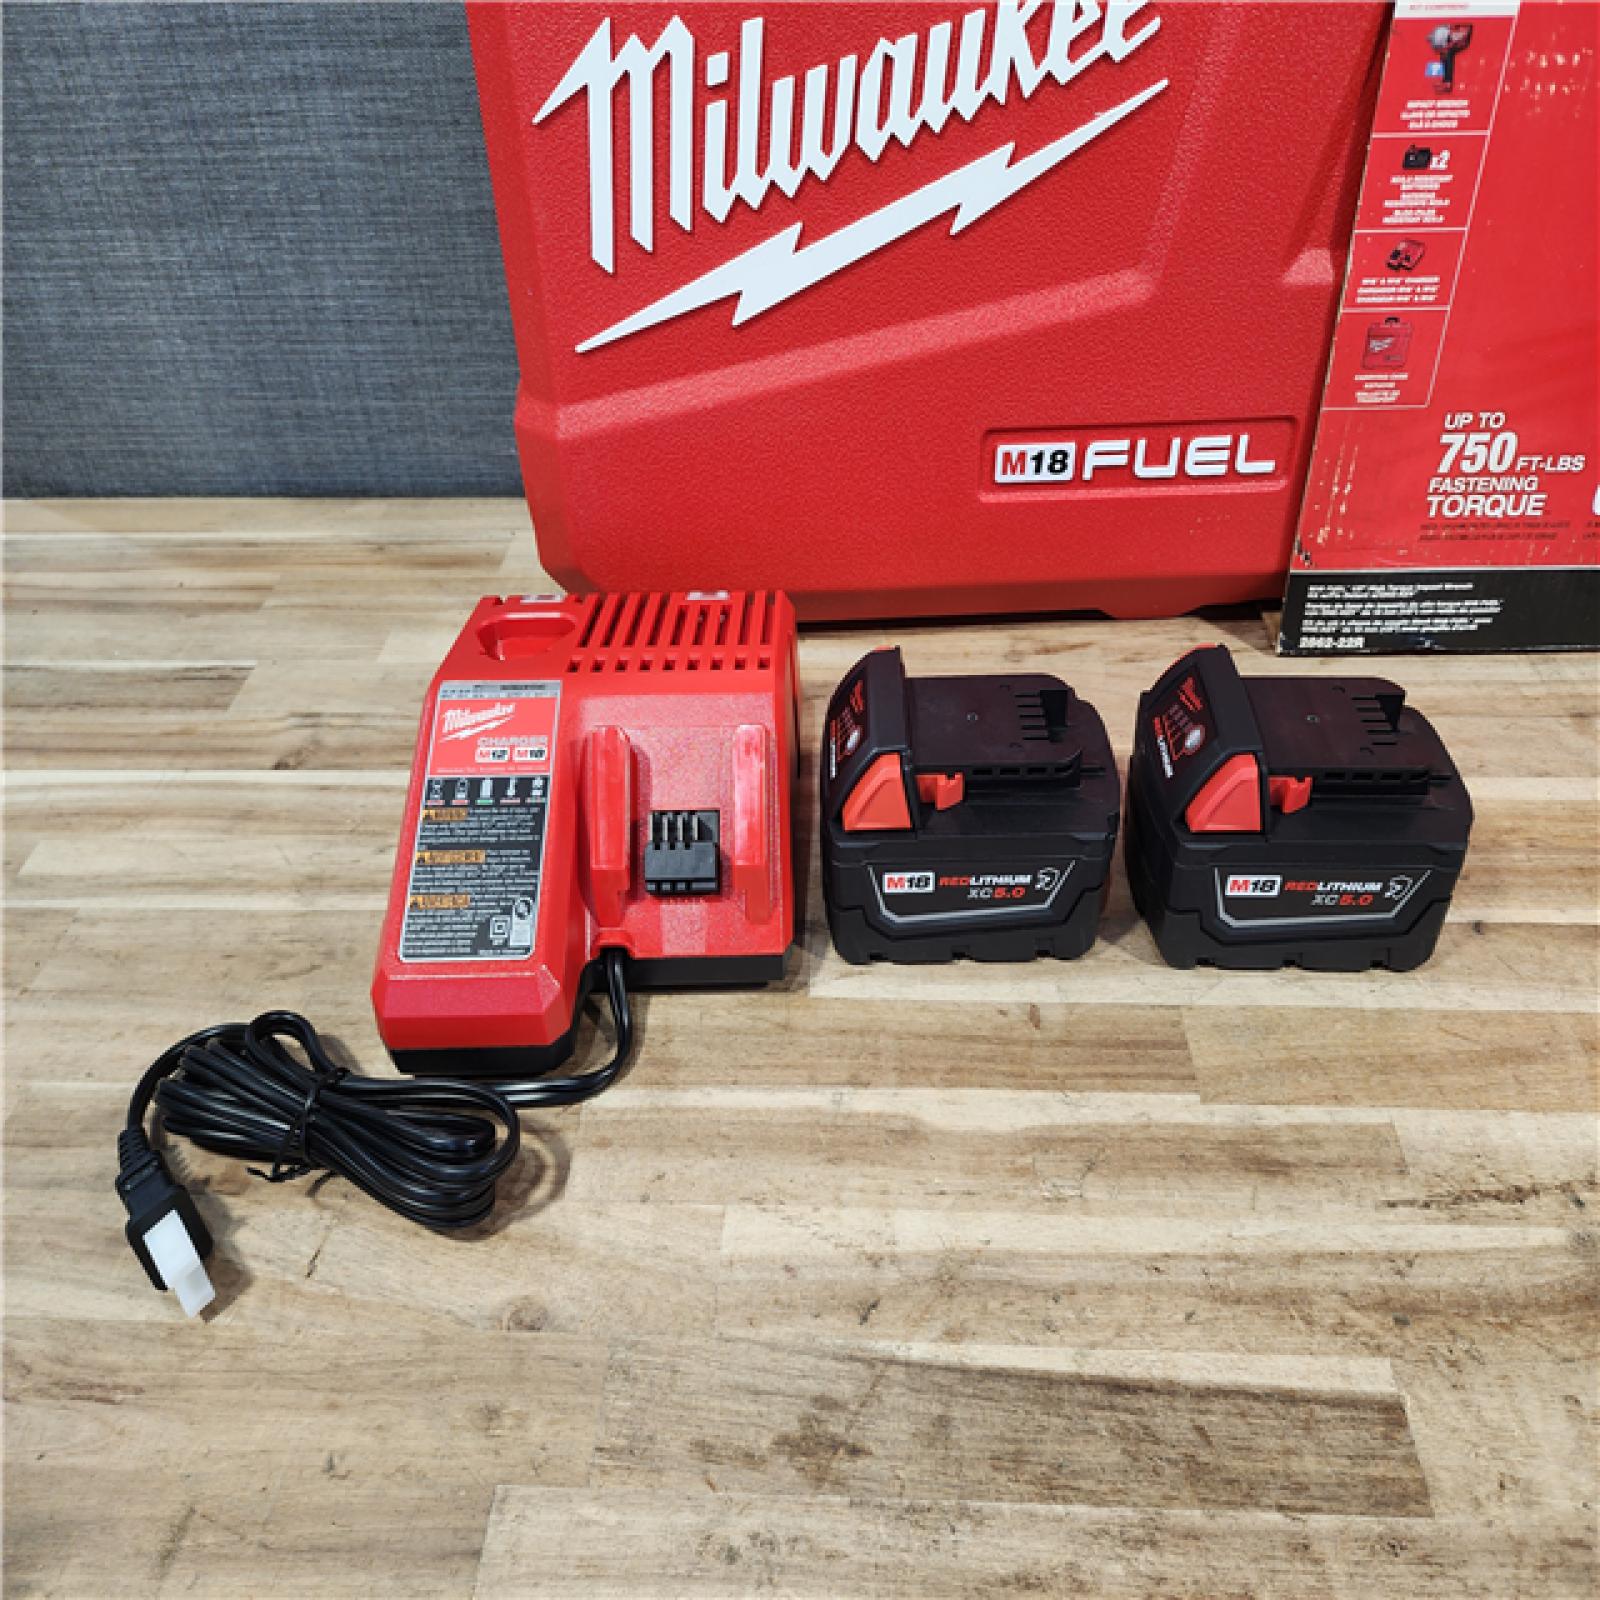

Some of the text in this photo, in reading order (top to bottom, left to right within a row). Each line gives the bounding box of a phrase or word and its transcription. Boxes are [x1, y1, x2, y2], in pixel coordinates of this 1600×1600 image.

[532, 0, 1162, 273] Milwaukee
[1444, 411, 1506, 430] UP TO
[999, 434, 1276, 481] M18 FUEL
[1437, 431, 1586, 474] 750 FT-LBS
[1429, 475, 1539, 493] FASTENING
[1426, 494, 1548, 518] TORQUE
[884, 873, 1032, 891] M18 REDLITHIUM
[1227, 876, 1384, 894] M18 REDLITHIUM
